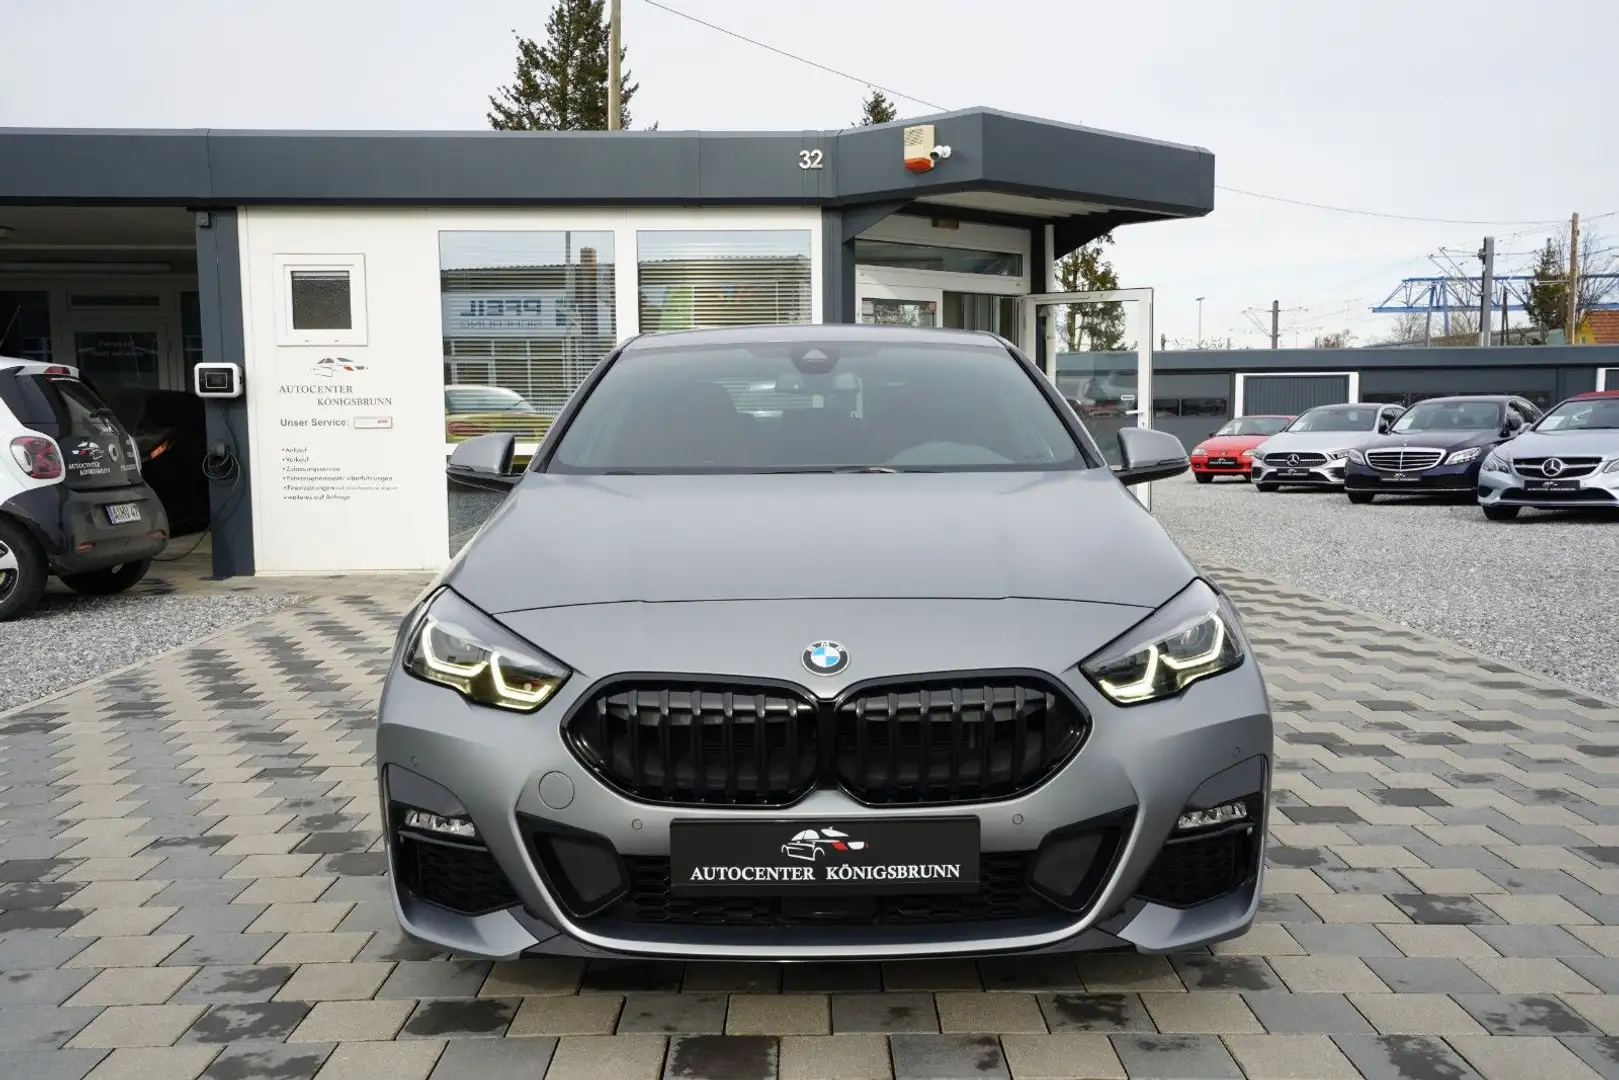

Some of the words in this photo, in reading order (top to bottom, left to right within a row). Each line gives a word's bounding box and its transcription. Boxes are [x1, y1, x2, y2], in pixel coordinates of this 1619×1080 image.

[798, 149, 823, 170] 32
[279, 385, 354, 394] AUTOCENTER
[317, 397, 392, 406] KÖNIGSBRUNN
[280, 417, 308, 427] Unser
[311, 417, 349, 427] Service:
[690, 866, 816, 881] AUTOCENTER
[825, 863, 962, 880] KÖNIGSBRUNN
